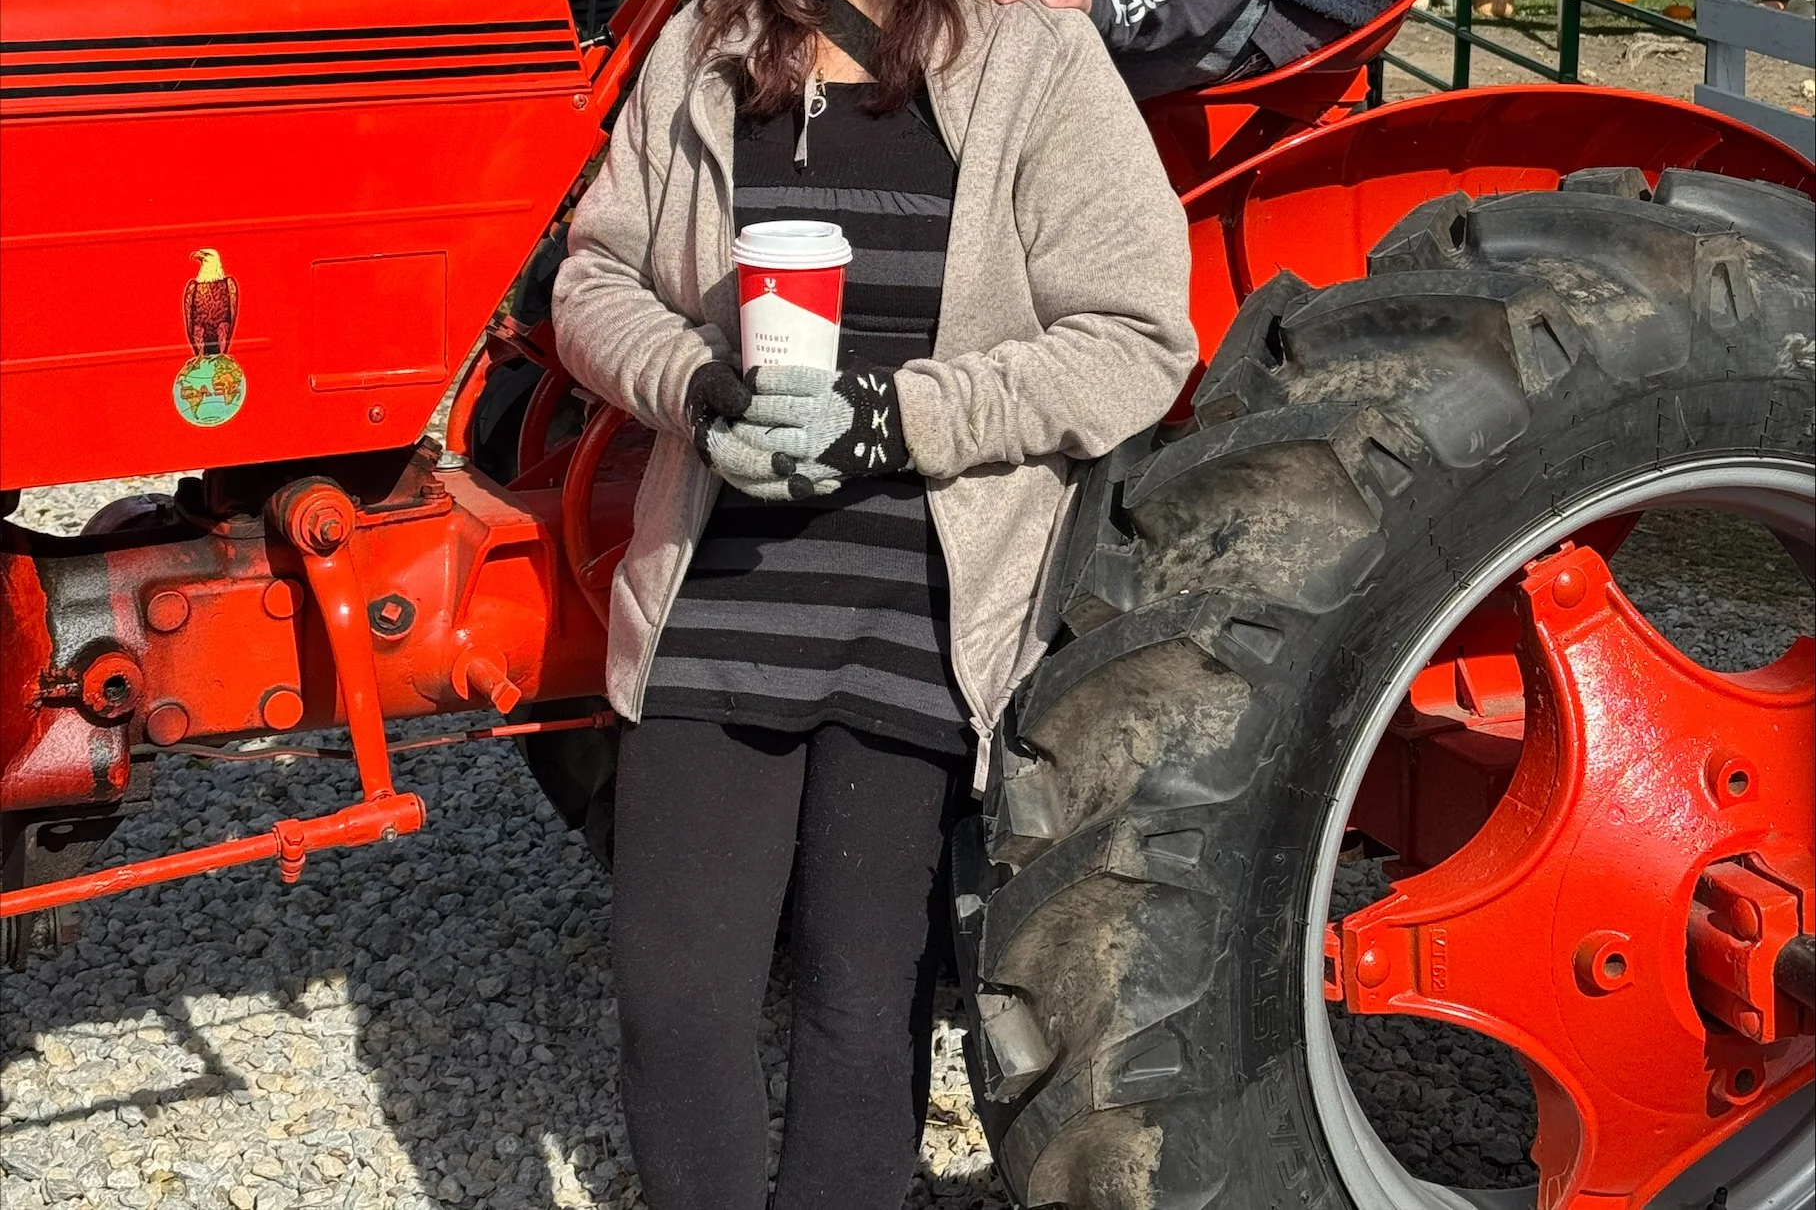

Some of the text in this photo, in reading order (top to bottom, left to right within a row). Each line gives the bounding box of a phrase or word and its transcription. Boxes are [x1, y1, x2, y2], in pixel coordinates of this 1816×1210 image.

[755, 332, 789, 342] FRESHLY
[756, 344, 788, 354] GROUND
[763, 357, 779, 365] AND
